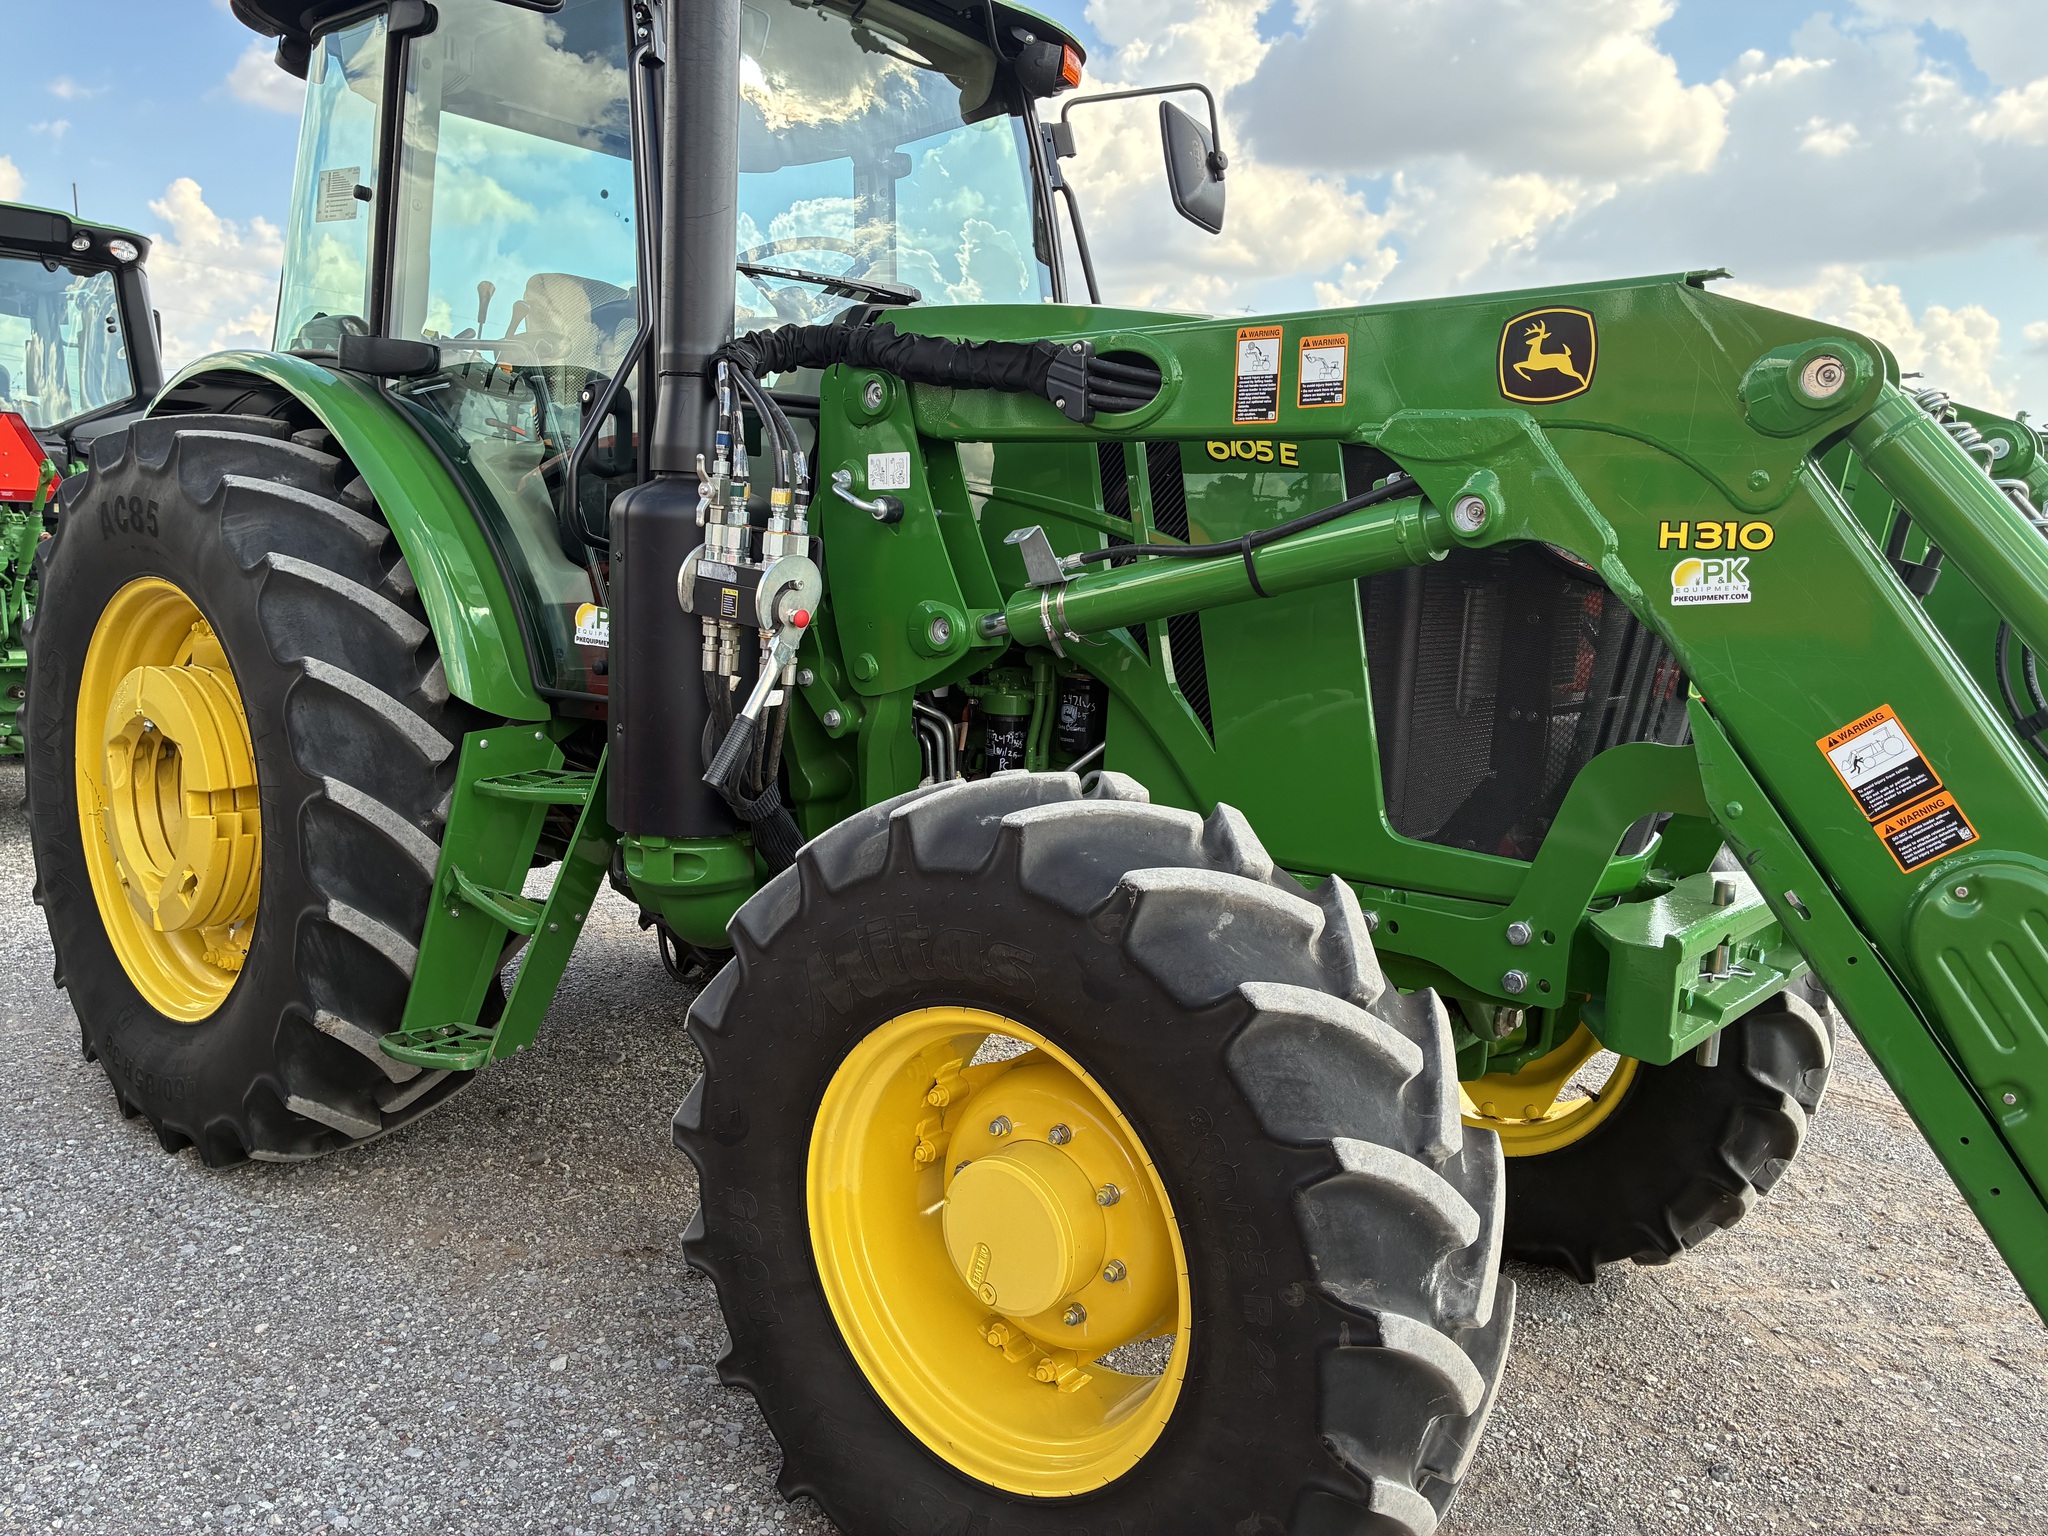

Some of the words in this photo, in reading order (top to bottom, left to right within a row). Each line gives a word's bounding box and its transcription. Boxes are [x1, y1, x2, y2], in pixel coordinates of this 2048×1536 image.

[1248, 329, 1280, 338] WARNING
[1311, 337, 1346, 347] WARNING
[1205, 440, 1274, 465] 6105
[1279, 441, 1299, 468] E
[100, 494, 160, 541] AC85
[1673, 593, 1749, 602] PKEQUIPMENT.COM
[1675, 584, 1747, 594] EQUIPMENT
[1837, 712, 1885, 741] WARNING
[1896, 799, 1946, 827] WARNING
[806, 912, 1037, 1039] Mitas
[726, 1186, 784, 1325] AC85
